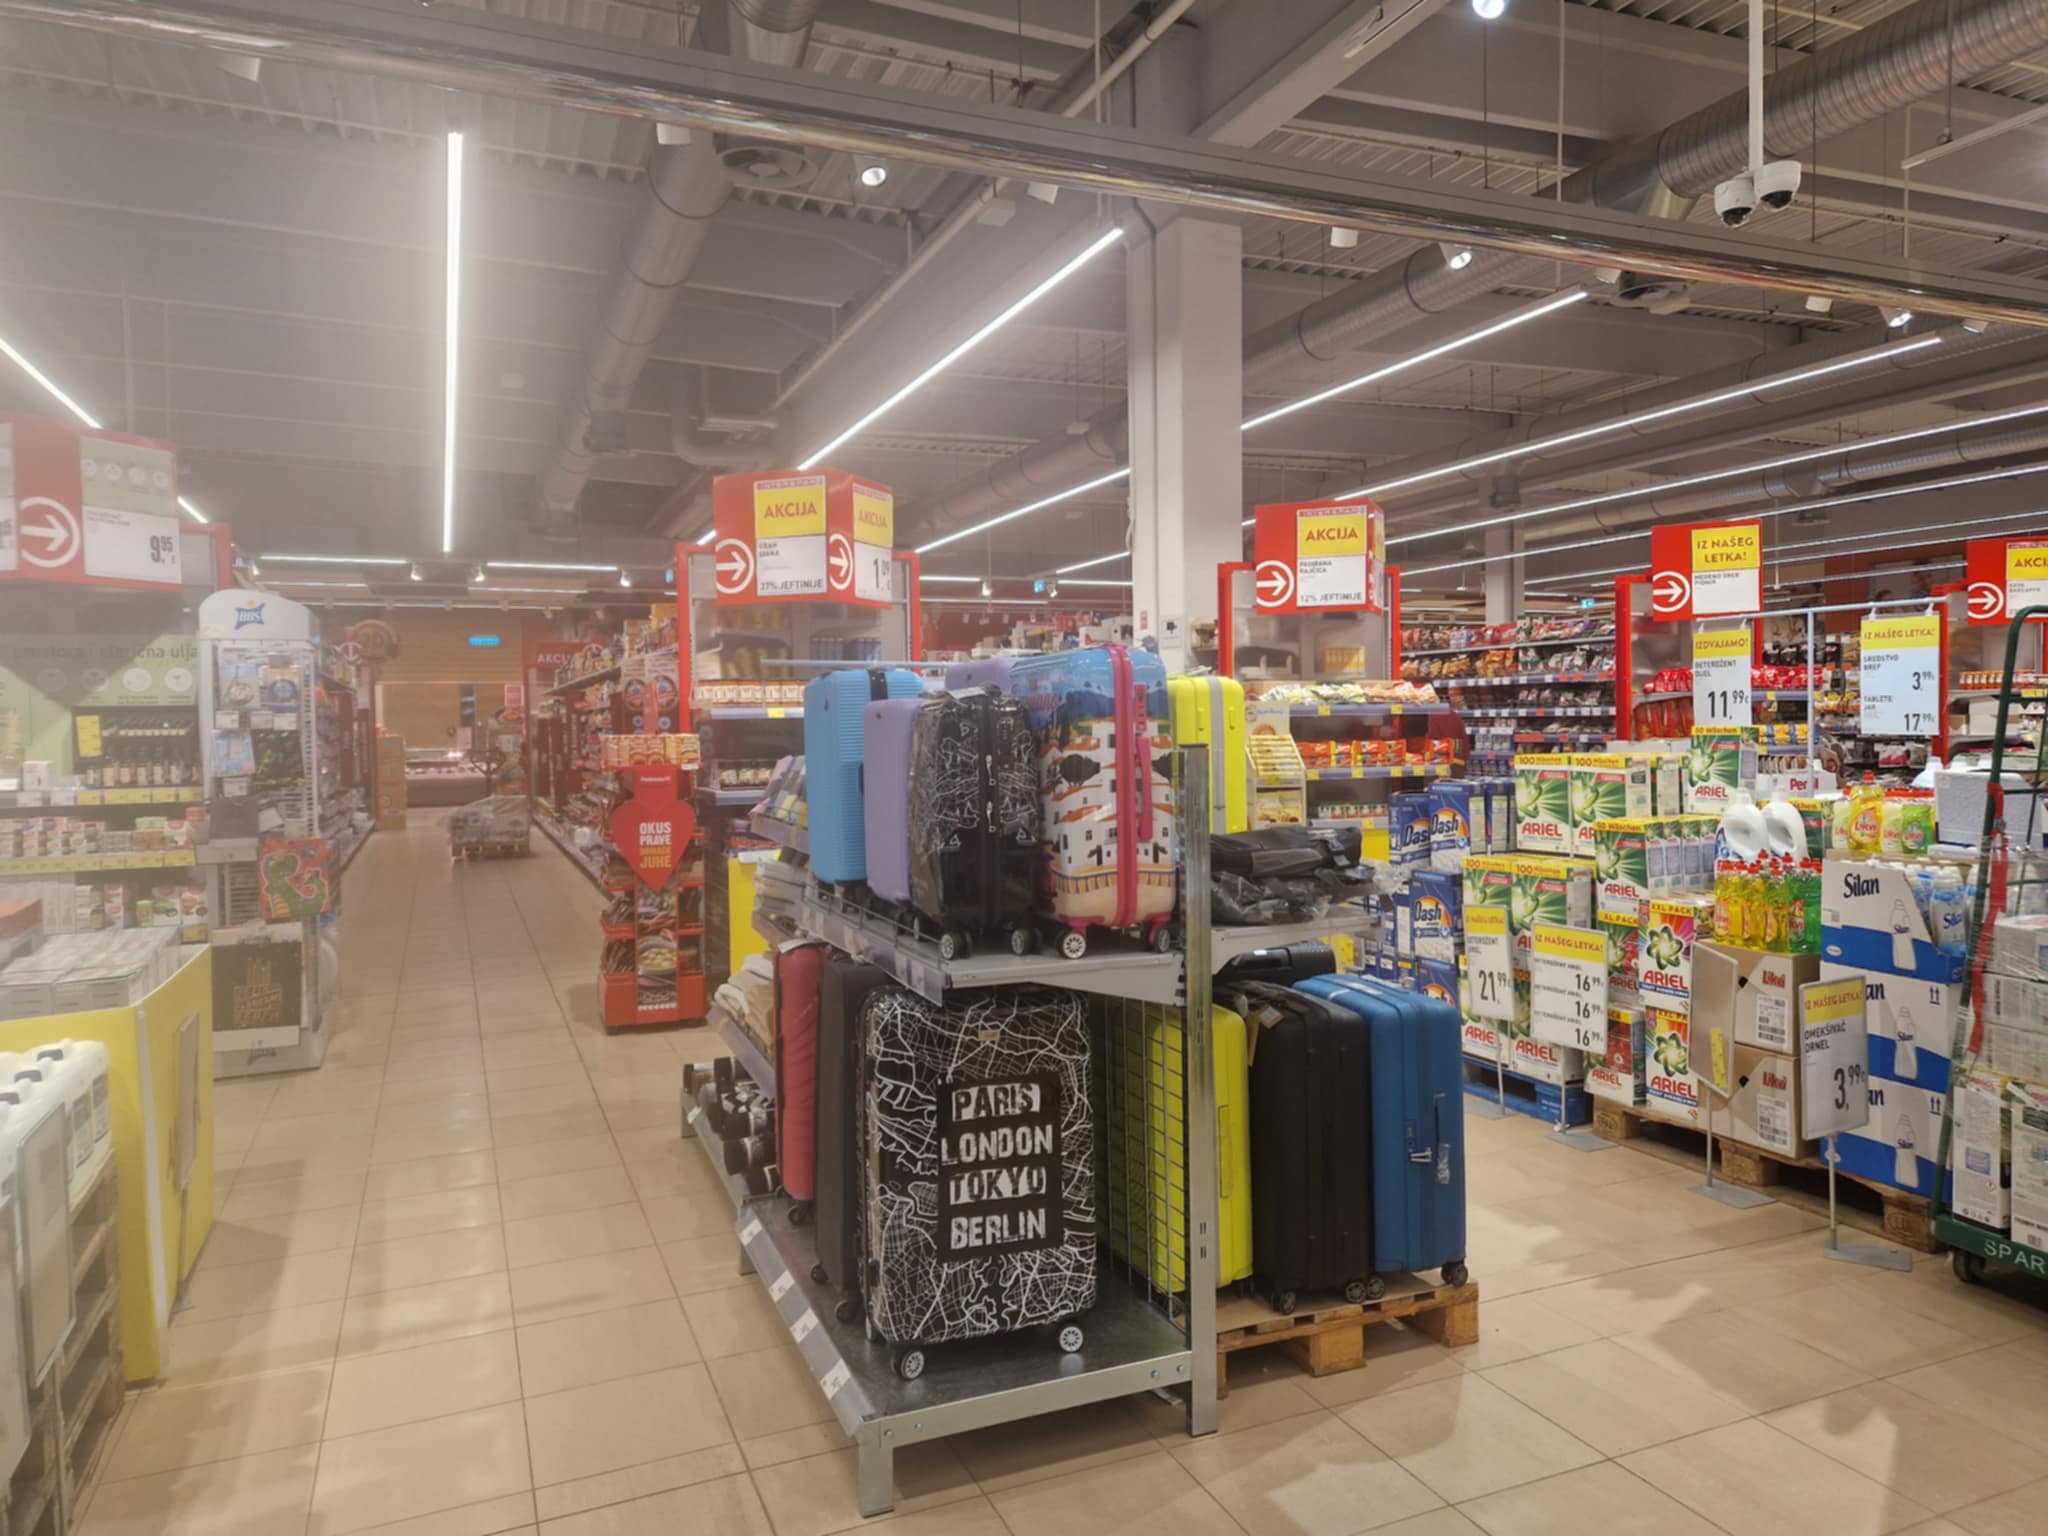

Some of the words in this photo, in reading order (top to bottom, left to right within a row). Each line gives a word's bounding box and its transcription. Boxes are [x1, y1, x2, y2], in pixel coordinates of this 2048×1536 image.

[764, 501, 818, 520] AKCIJA
[858, 510, 888, 529] AKCIJA
[1305, 527, 1359, 542] AKCIJA
[1697, 539, 1709, 549] IZ
[1711, 536, 1754, 548] NAŠEG
[1704, 552, 1747, 563] LETKA!
[1864, 631, 1872, 640] IZ
[1873, 629, 1904, 639] NAŠEG
[1905, 627, 1935, 638] LETKA!
[1695, 637, 1749, 650] IZDVAJAMO!
[1520, 757, 1536, 765] 100
[1576, 758, 1592, 767] 100
[1695, 785, 1729, 798] ARIEL
[639, 822, 672, 835] OKUS
[1430, 814, 1460, 836] Dash
[1521, 822, 1563, 837] ARIEL
[1403, 825, 1431, 848] Das
[1516, 864, 1533, 874] 100
[1604, 883, 1640, 898] ARIEL
[1843, 872, 1881, 899] Silan
[1414, 900, 1442, 923] Dash
[1534, 934, 1543, 944] IZ
[1543, 936, 1572, 947] NAŠEG
[1573, 940, 1604, 953] LETKA!
[1643, 969, 1690, 991] ARIEL
[1762, 969, 1786, 988] Likvi
[1812, 996, 1837, 1009] NAŠEG
[1465, 1025, 1503, 1048] ARIE
[1804, 1020, 1848, 1040] OMEKŠIVAČ
[1515, 1038, 1559, 1062] ARIEL
[1591, 1070, 1623, 1087] ARIEL
[1650, 1075, 1697, 1099] ARIEL
[1762, 1071, 1788, 1090] Likvi
[952, 1083, 1041, 1122] PARIS
[941, 1124, 1053, 1166] LONDON
[950, 1166, 1047, 1205] TOKYO
[951, 1207, 1047, 1250] BERLIN
[1983, 1239, 2046, 1275] SPAR
